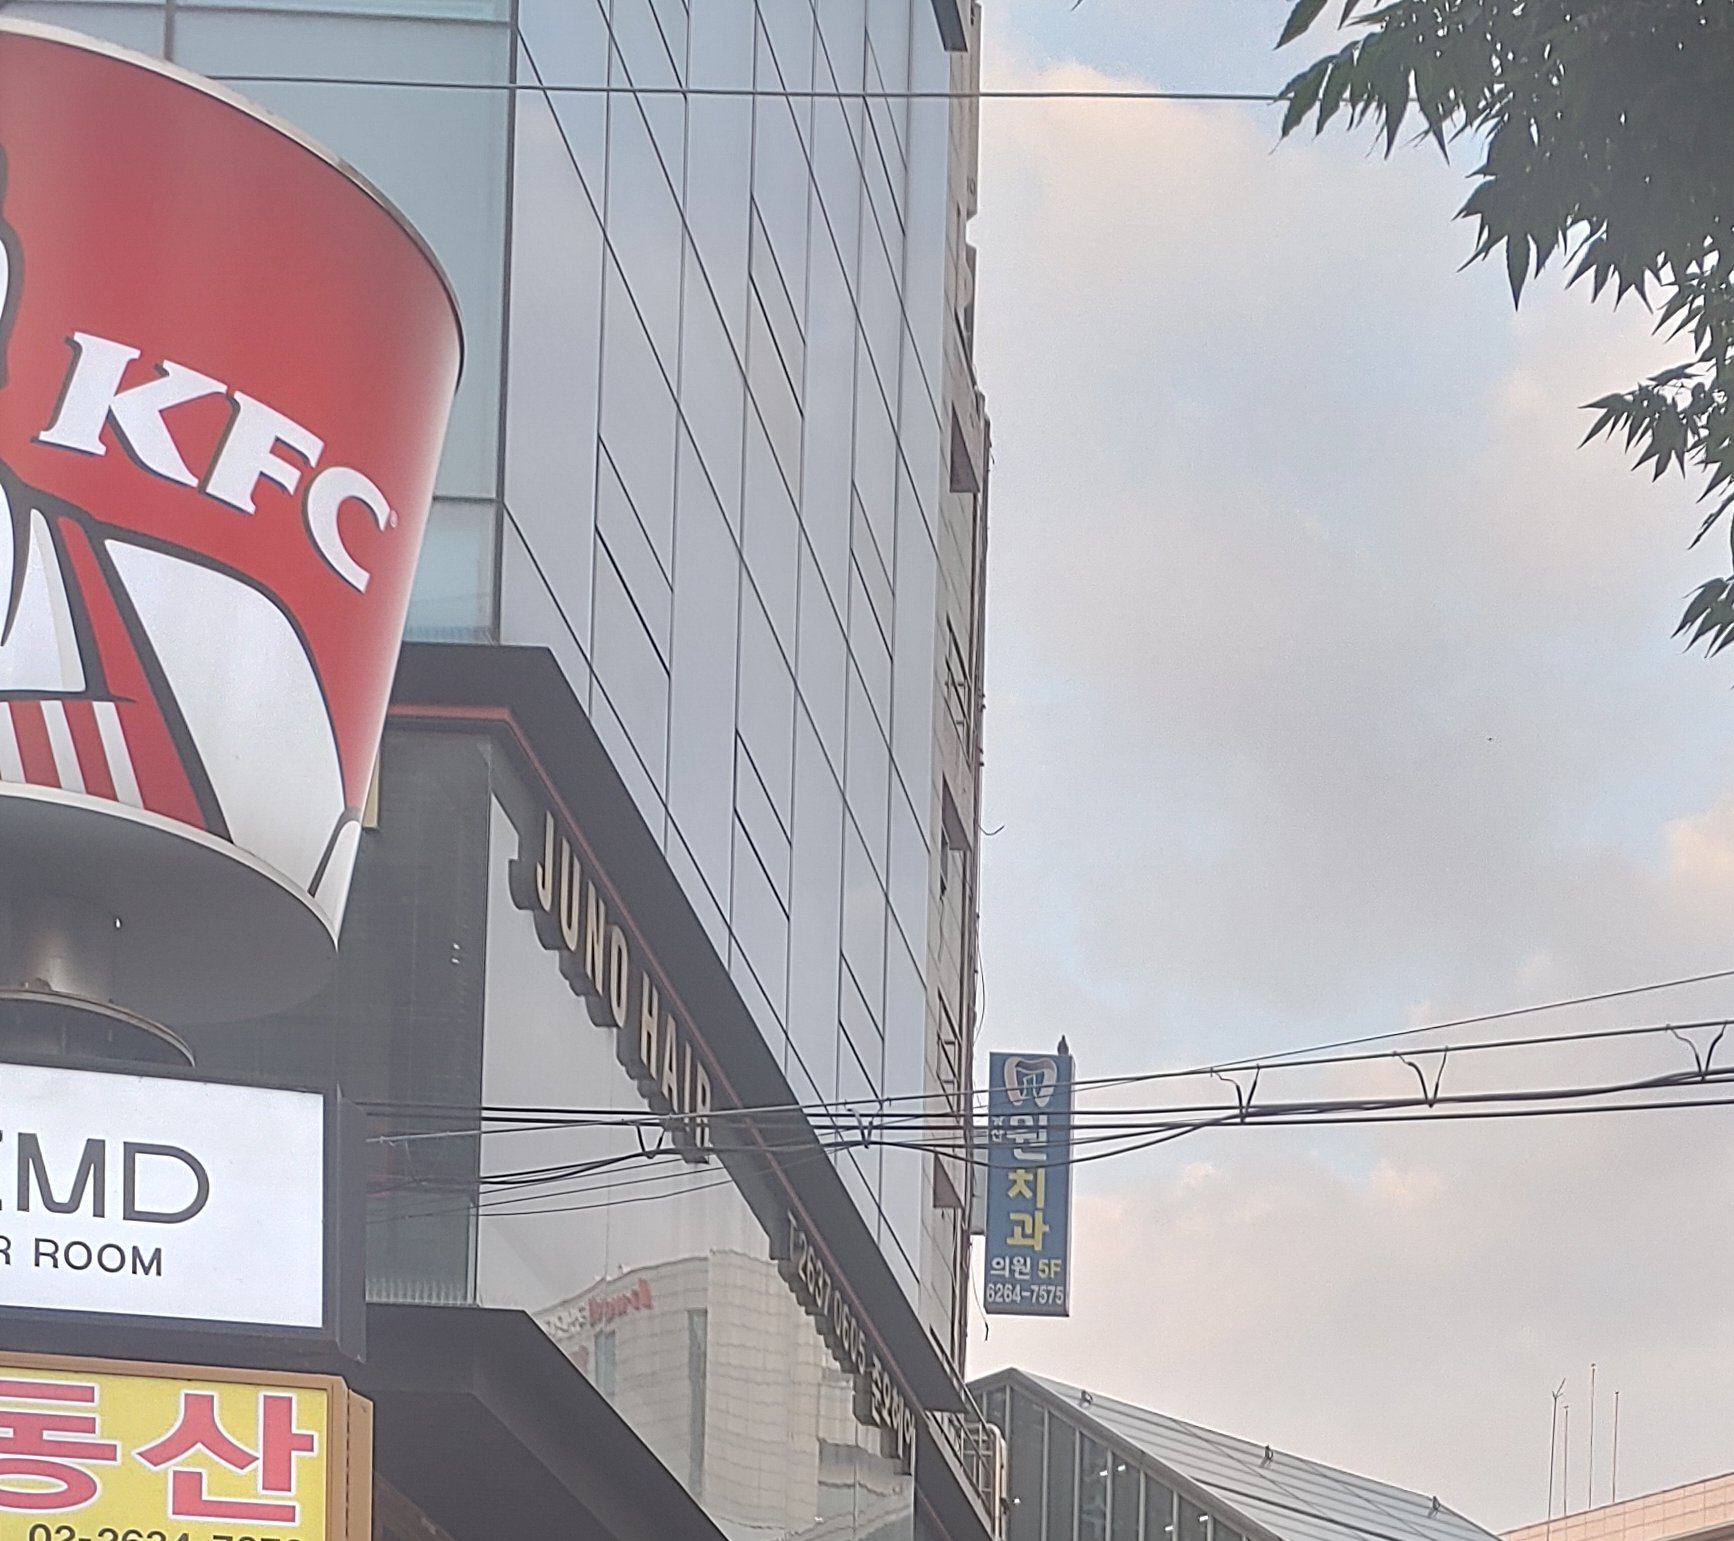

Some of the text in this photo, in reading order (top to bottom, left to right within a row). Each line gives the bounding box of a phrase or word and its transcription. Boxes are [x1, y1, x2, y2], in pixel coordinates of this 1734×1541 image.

[39, 331, 391, 593] KFC
[536, 810, 711, 1147] JUNO HAIR
[0, 1130, 209, 1224] MD
[34, 1238, 162, 1276] ROOM
[799, 1232, 832, 1316] 2637
[987, 1284, 1064, 1304] 6264-7575
[990, 1257, 1062, 1279] 의원 5F
